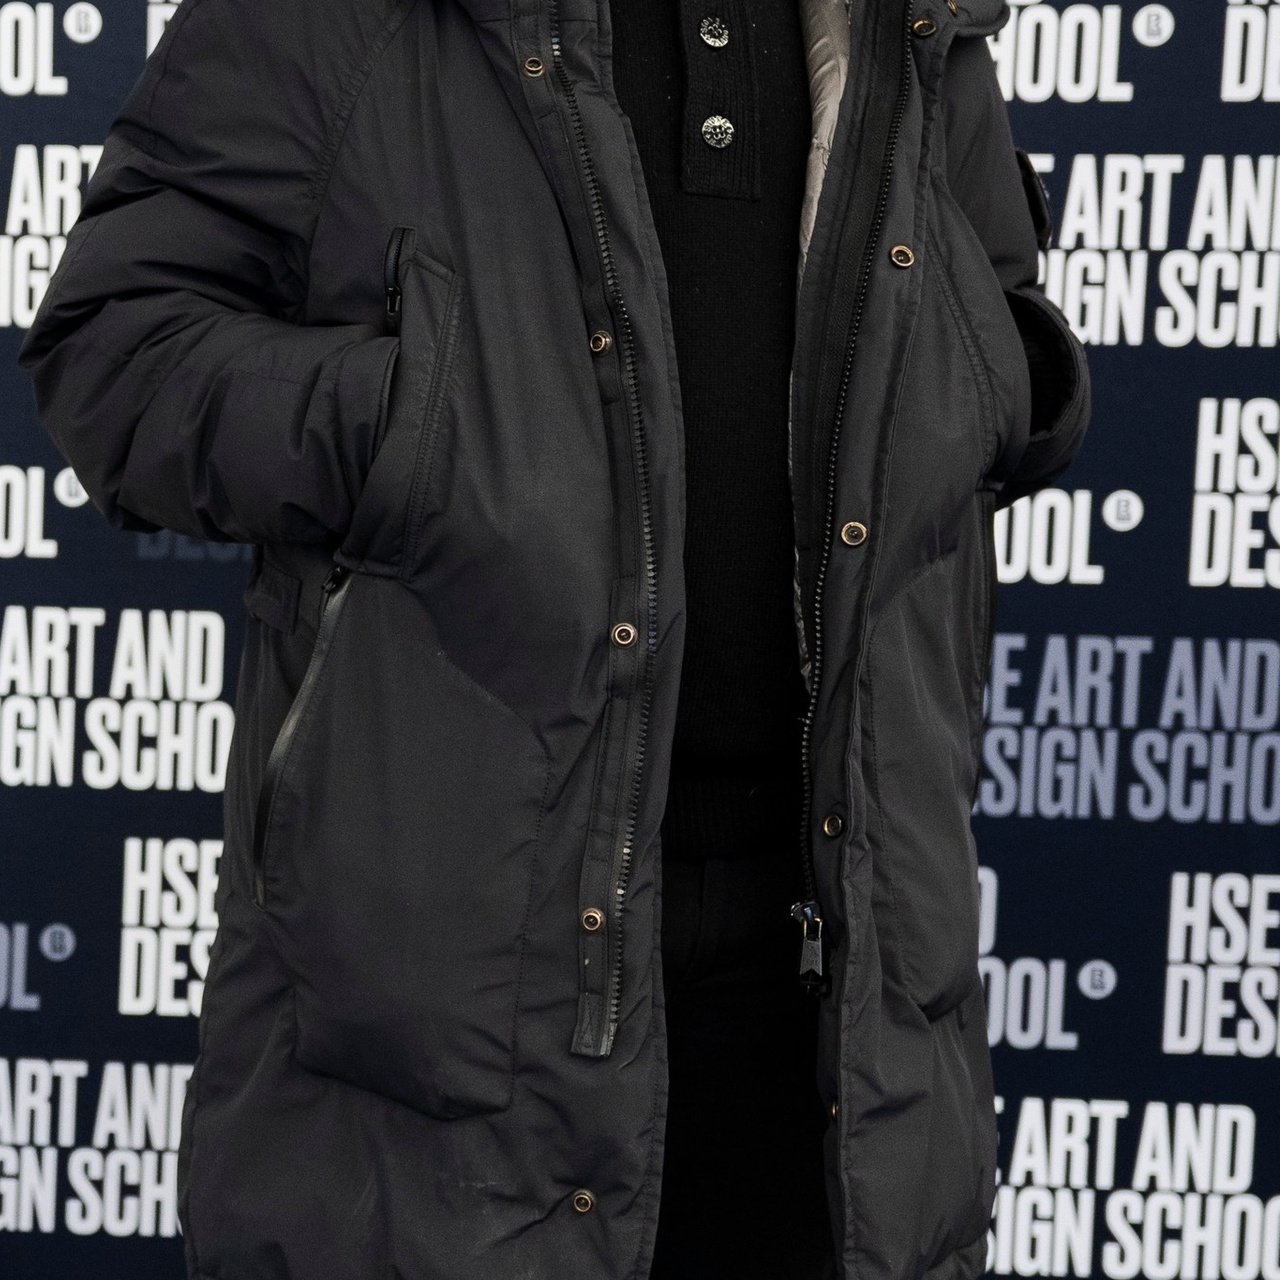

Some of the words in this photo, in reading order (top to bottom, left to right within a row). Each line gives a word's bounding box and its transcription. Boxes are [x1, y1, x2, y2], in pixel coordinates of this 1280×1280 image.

[987, 4, 1135, 104] HOOL
[1059, 153, 1186, 251] ART
[1188, 153, 1280, 252] AN
[1155, 250, 1280, 349] SCH
[110, 607, 226, 702] AND
[1033, 634, 1154, 729] ART
[82, 697, 237, 794] SCHO
[973, 726, 1120, 820] SIGN
[1128, 731, 1280, 825] SCHO
[1167, 871, 1280, 966] HSE
[1163, 964, 1280, 1059] DES
[65, 1147, 181, 1239] SCH
[1009, 1096, 1130, 1191] ART
[1132, 1101, 1257, 1196] AND
